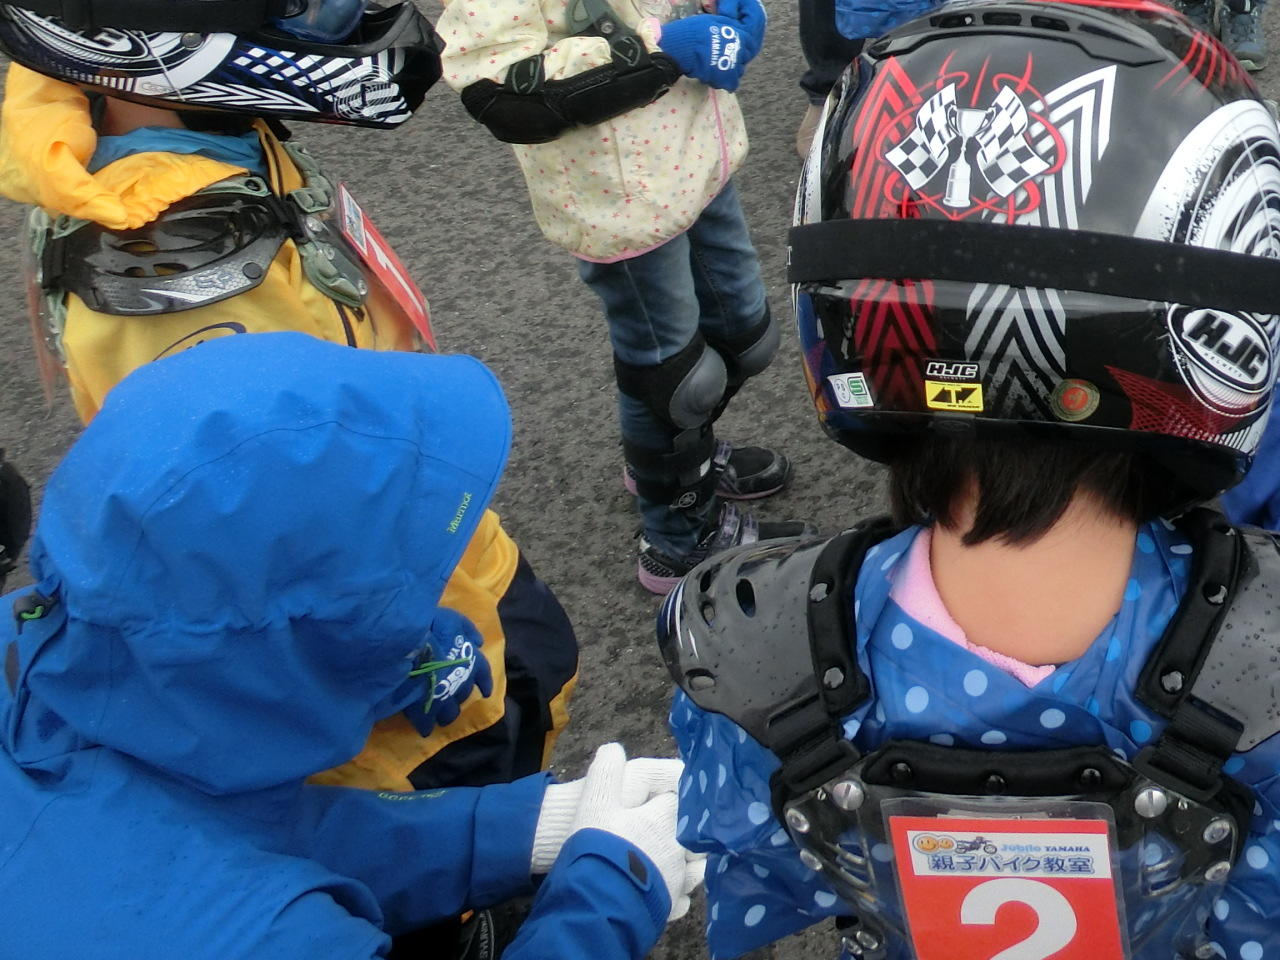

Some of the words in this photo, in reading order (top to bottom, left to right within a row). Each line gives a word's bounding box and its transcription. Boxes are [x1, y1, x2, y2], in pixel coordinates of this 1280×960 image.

[710, 34, 721, 66] YAMAHA
[1186, 312, 1268, 380] HJC
[926, 362, 978, 378] HJC
[1001, 844, 1041, 853] Jubilo
[931, 854, 1093, 874] 親子バイク教室
[961, 878, 1077, 960] 2
